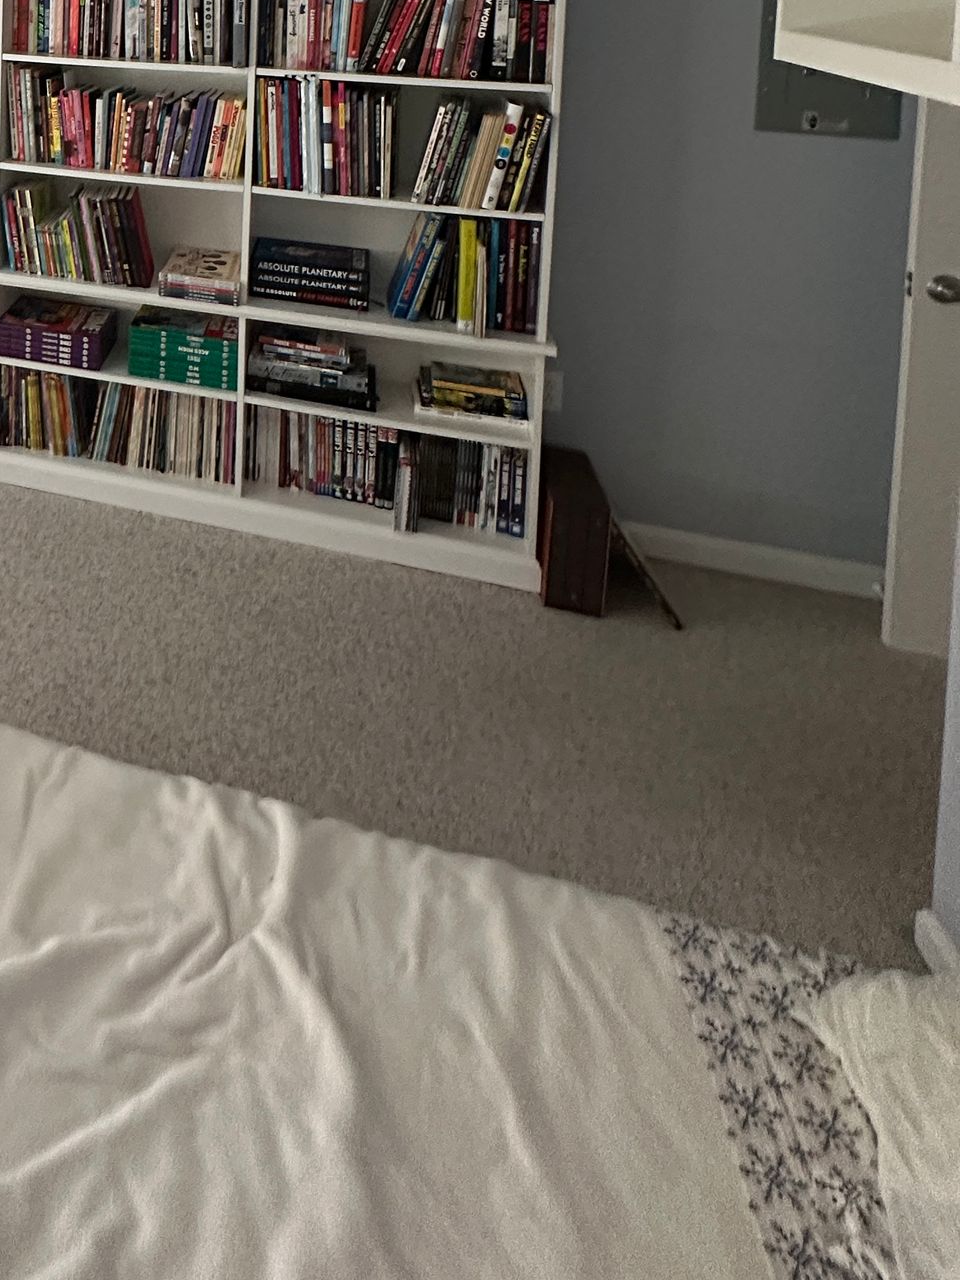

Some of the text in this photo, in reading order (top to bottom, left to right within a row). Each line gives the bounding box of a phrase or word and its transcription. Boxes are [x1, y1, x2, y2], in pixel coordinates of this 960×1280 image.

[477, 7, 492, 39] WORLD
[210, 125, 221, 145] POGO
[257, 261, 348, 280] ABSOLUTE PLANETARY
[257, 274, 347, 291] ABSOLUTE PLANETARY
[265, 288, 297, 297] ABSOLUTE
[178, 345, 210, 356] ACES HIGH
